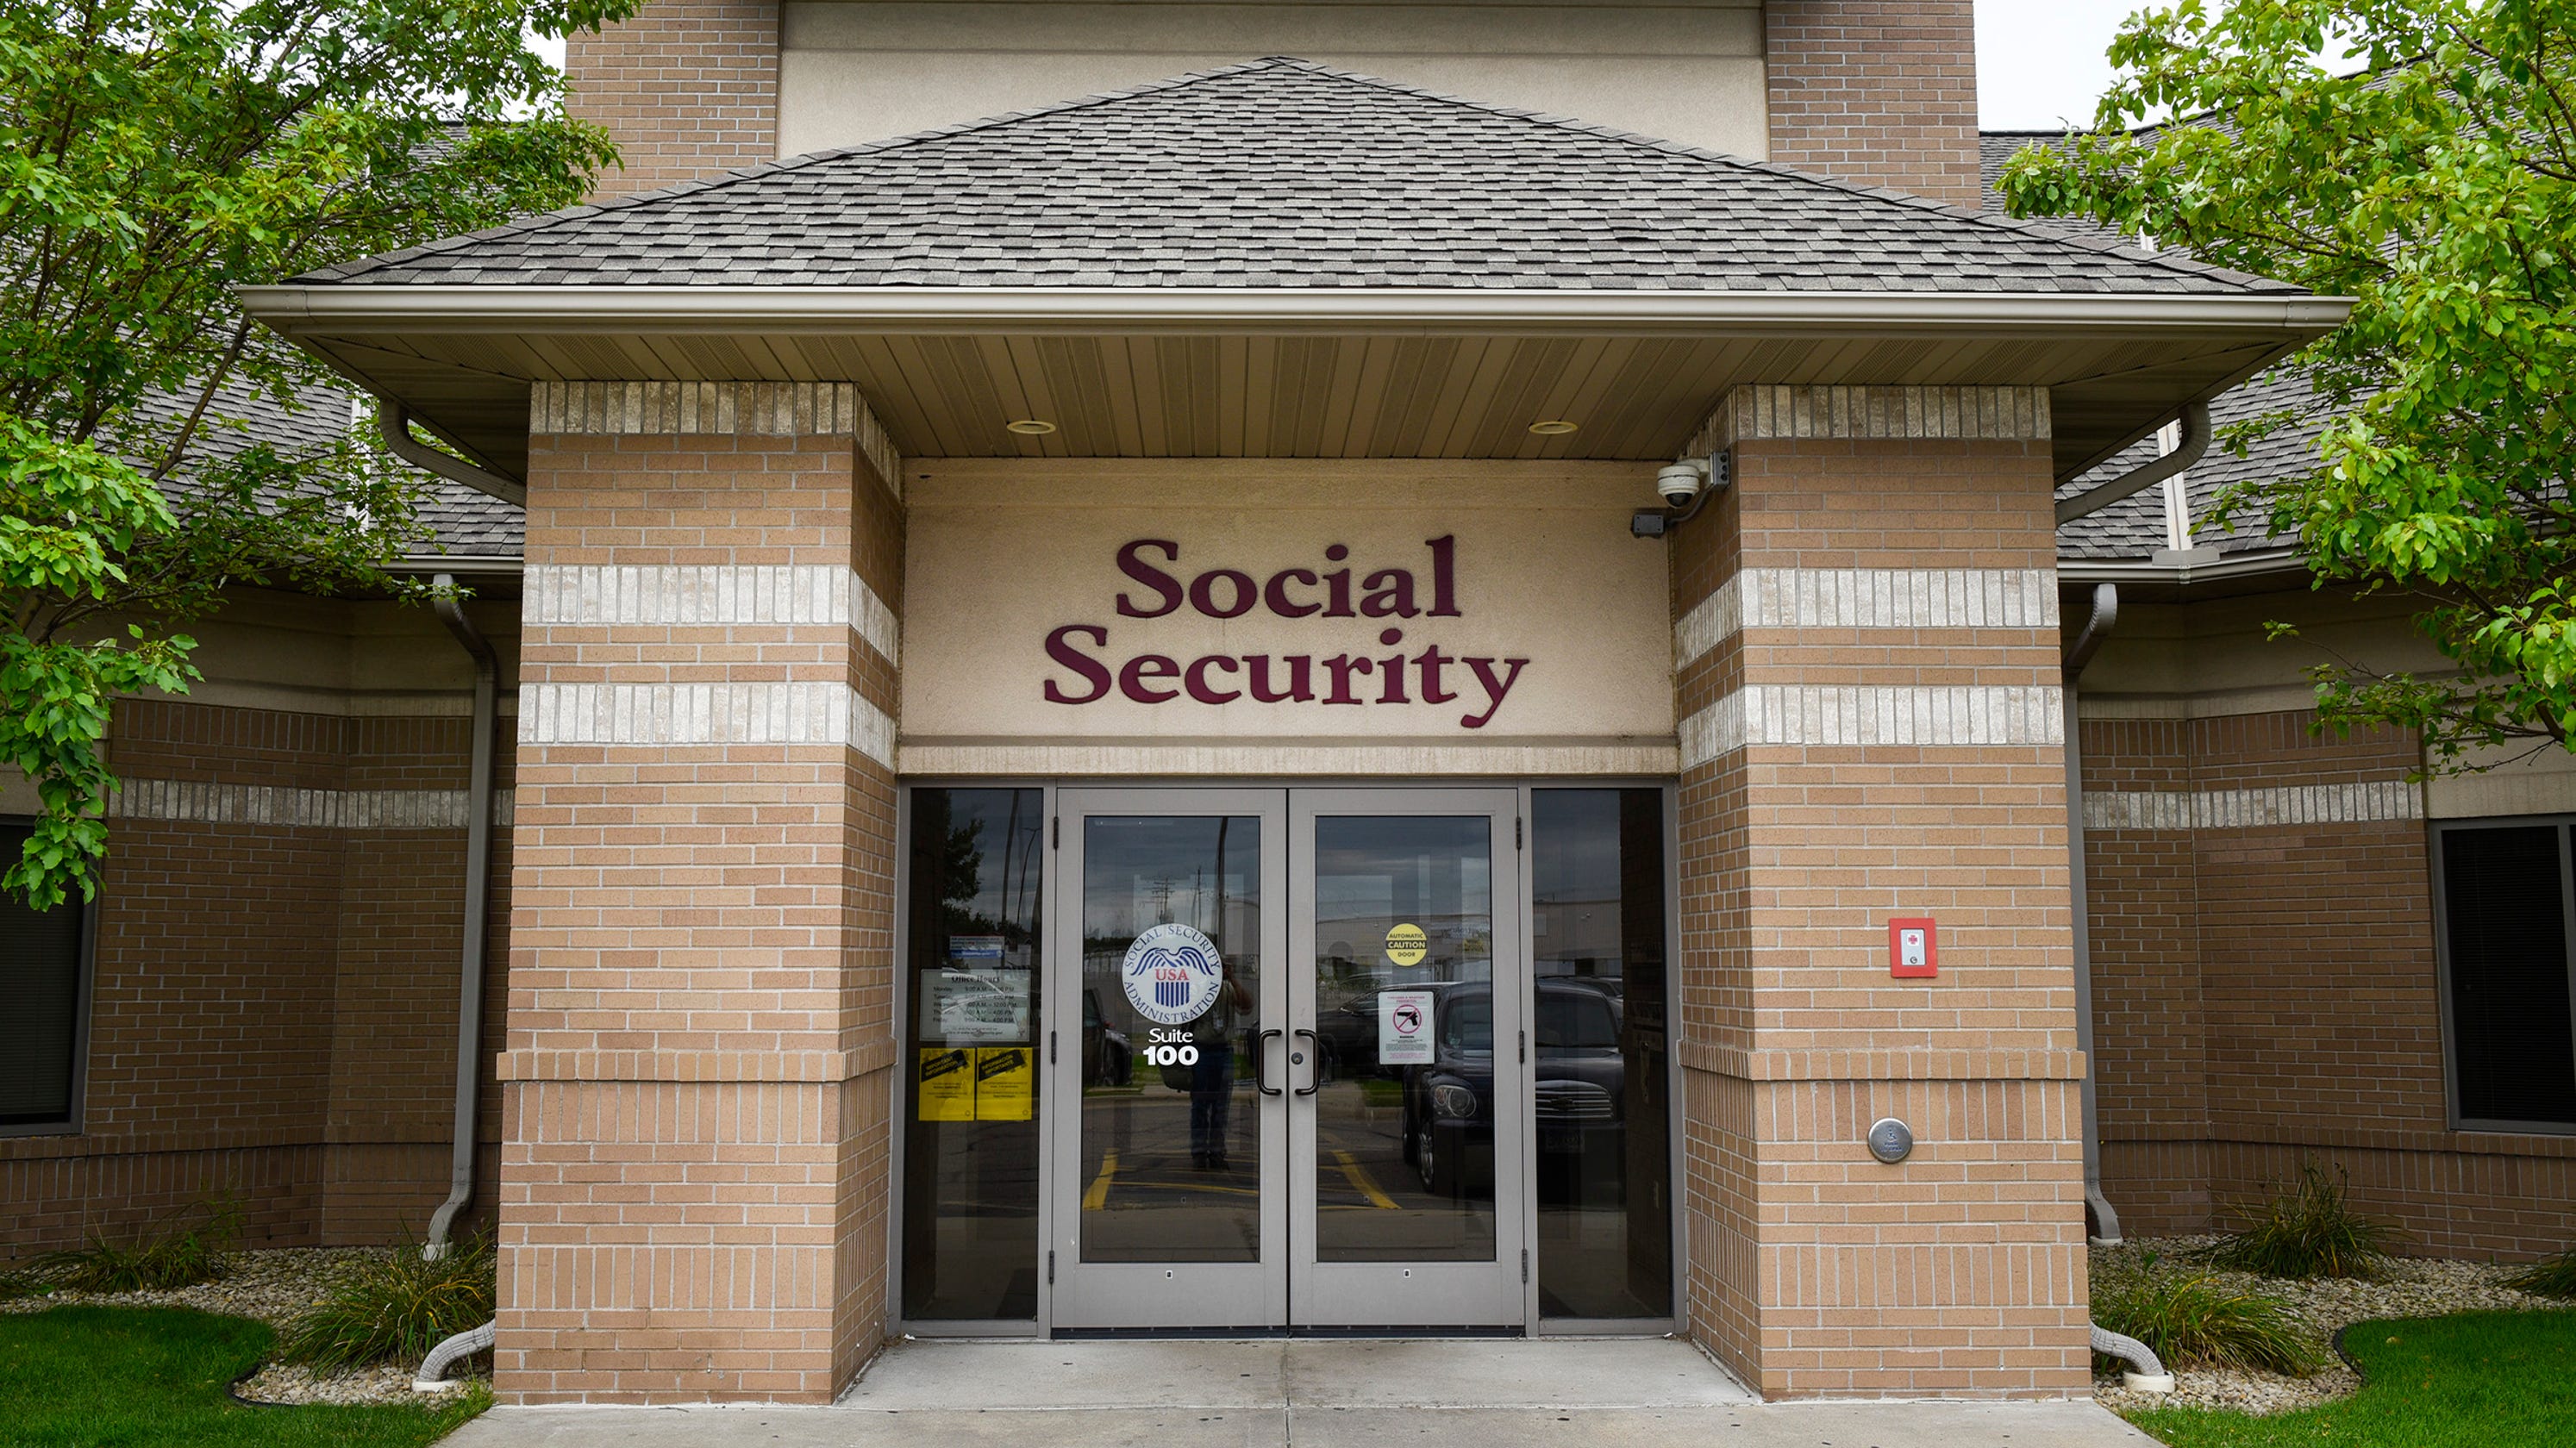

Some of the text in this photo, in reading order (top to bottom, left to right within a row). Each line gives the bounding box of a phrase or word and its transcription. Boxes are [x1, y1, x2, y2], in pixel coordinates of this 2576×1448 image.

[1116, 534, 1462, 619] Social
[1043, 624, 1530, 729] Security
[1125, 924, 1222, 969] SOCIAL SECURITY
[1155, 968, 1190, 981] USA
[1123, 981, 1219, 1023] ADMINISTRATION
[1142, 1045, 1199, 1066] 100
[1147, 1027, 1194, 1043] Suite
